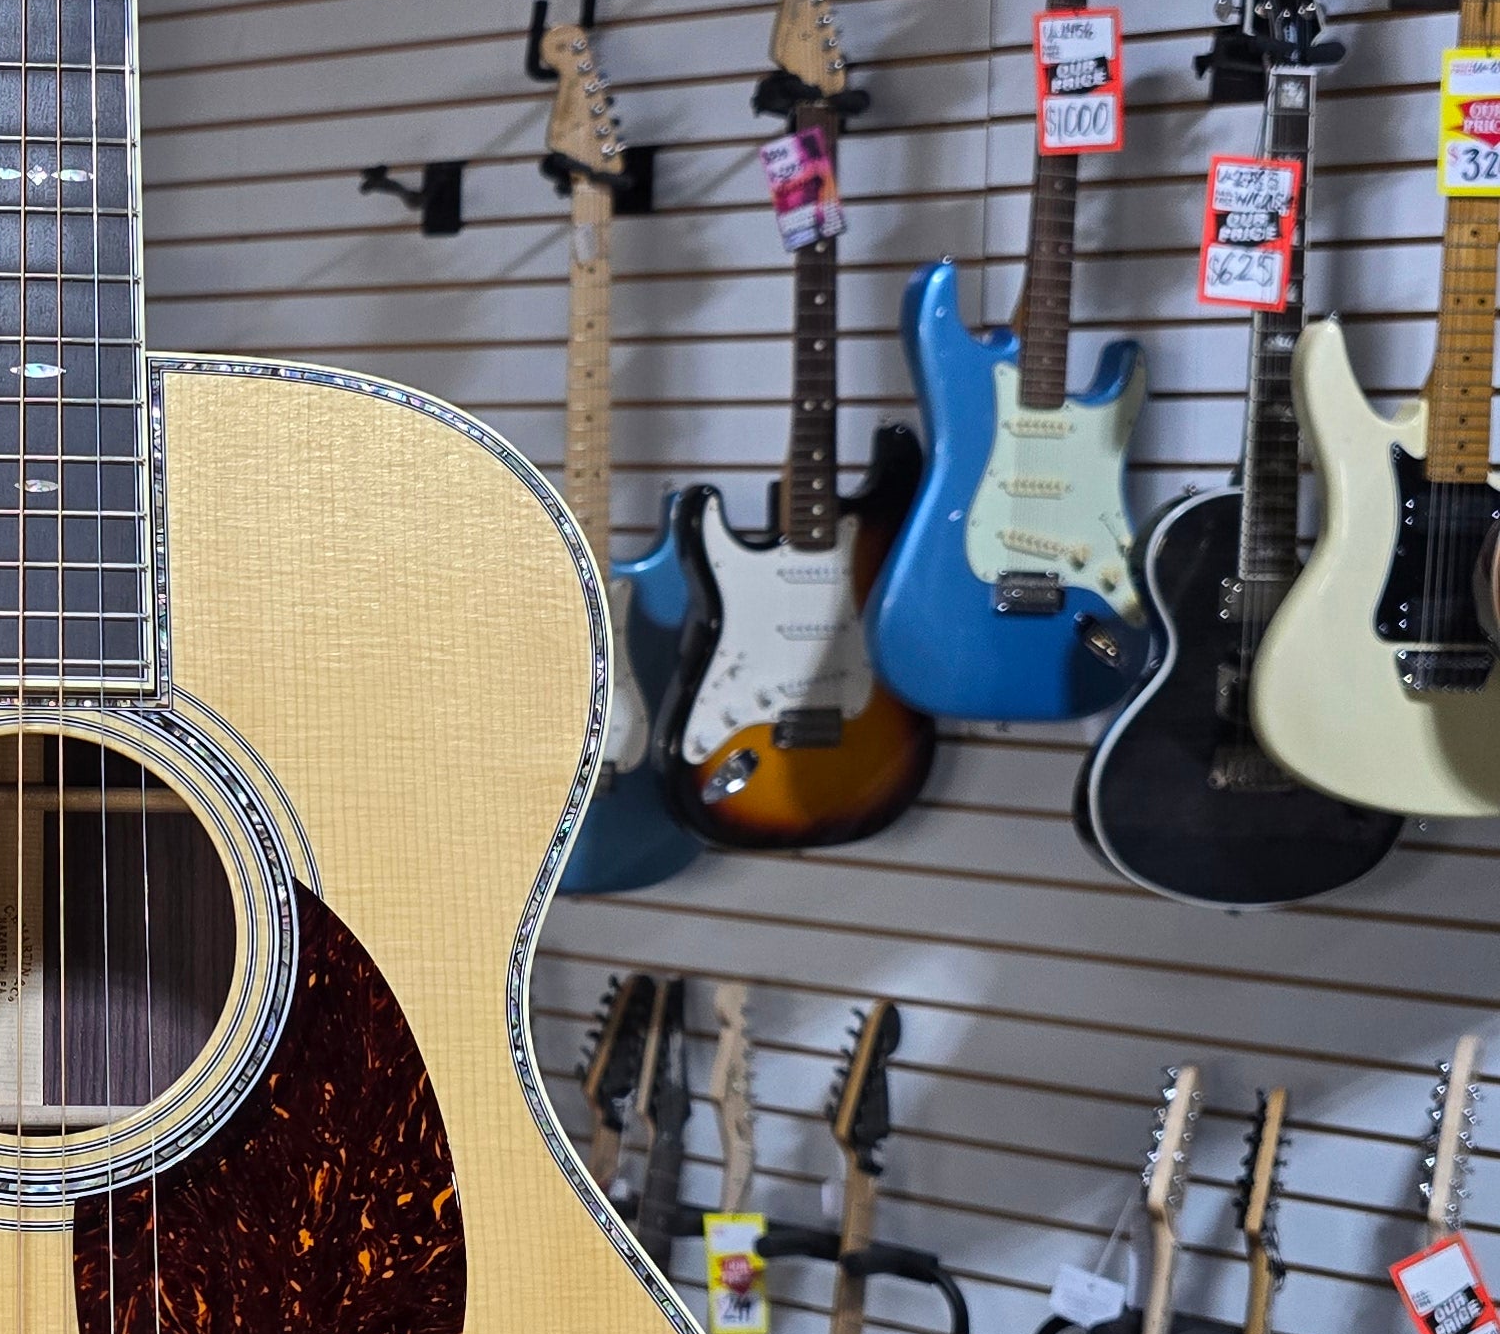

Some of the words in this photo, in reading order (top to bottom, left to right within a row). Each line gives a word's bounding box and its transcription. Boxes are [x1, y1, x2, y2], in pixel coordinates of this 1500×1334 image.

[1050, 69, 1108, 94] PRICE
[1056, 59, 1098, 79] OUR
[1045, 101, 1109, 142] $1000
[1226, 212, 1270, 228] OUR
[1218, 225, 1279, 243] PRICE
[1207, 251, 1275, 288] $625
[1433, 1290, 1467, 1324] OUR
